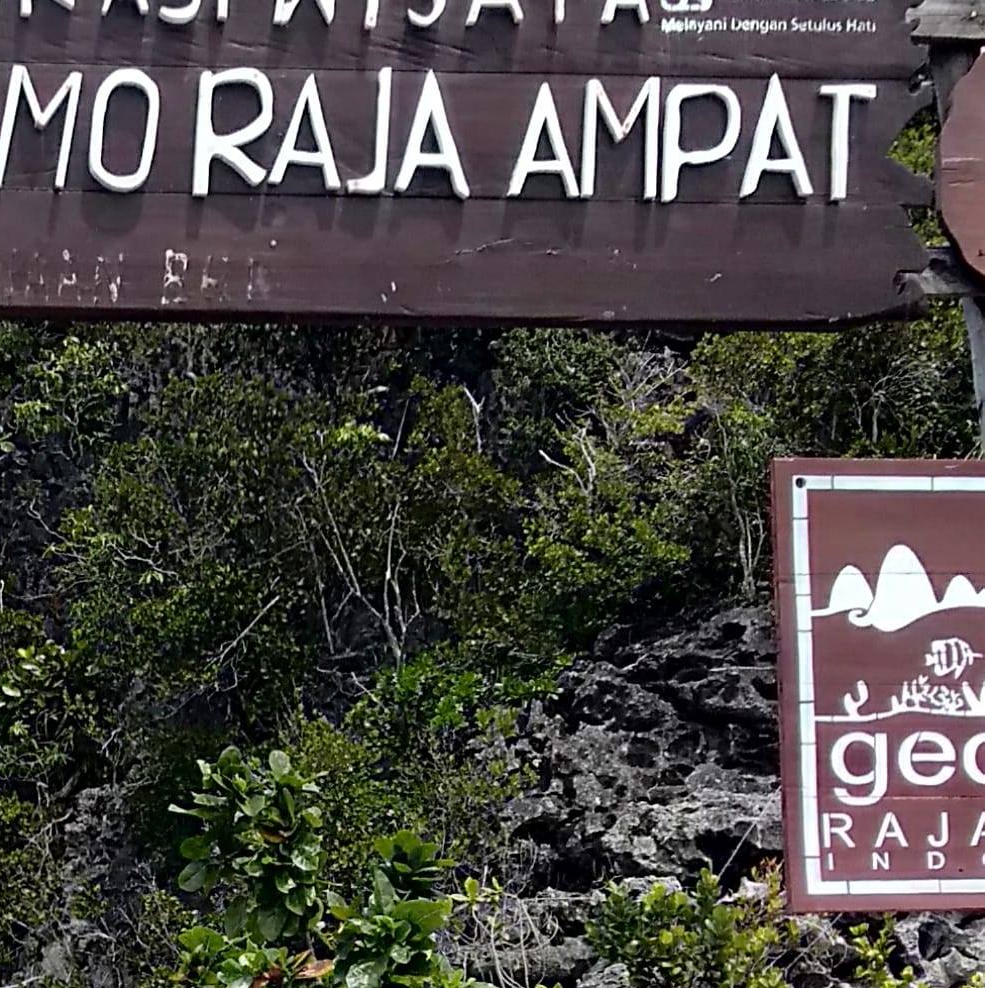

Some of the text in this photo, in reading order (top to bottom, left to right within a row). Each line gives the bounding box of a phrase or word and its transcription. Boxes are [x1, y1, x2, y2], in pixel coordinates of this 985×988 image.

[661, 17, 876, 34] Melayani Dengan Setulus Hati
[192, 66, 470, 199] RAJA
[506, 72, 878, 203] AMPAT
[827, 851, 985, 871] IND
